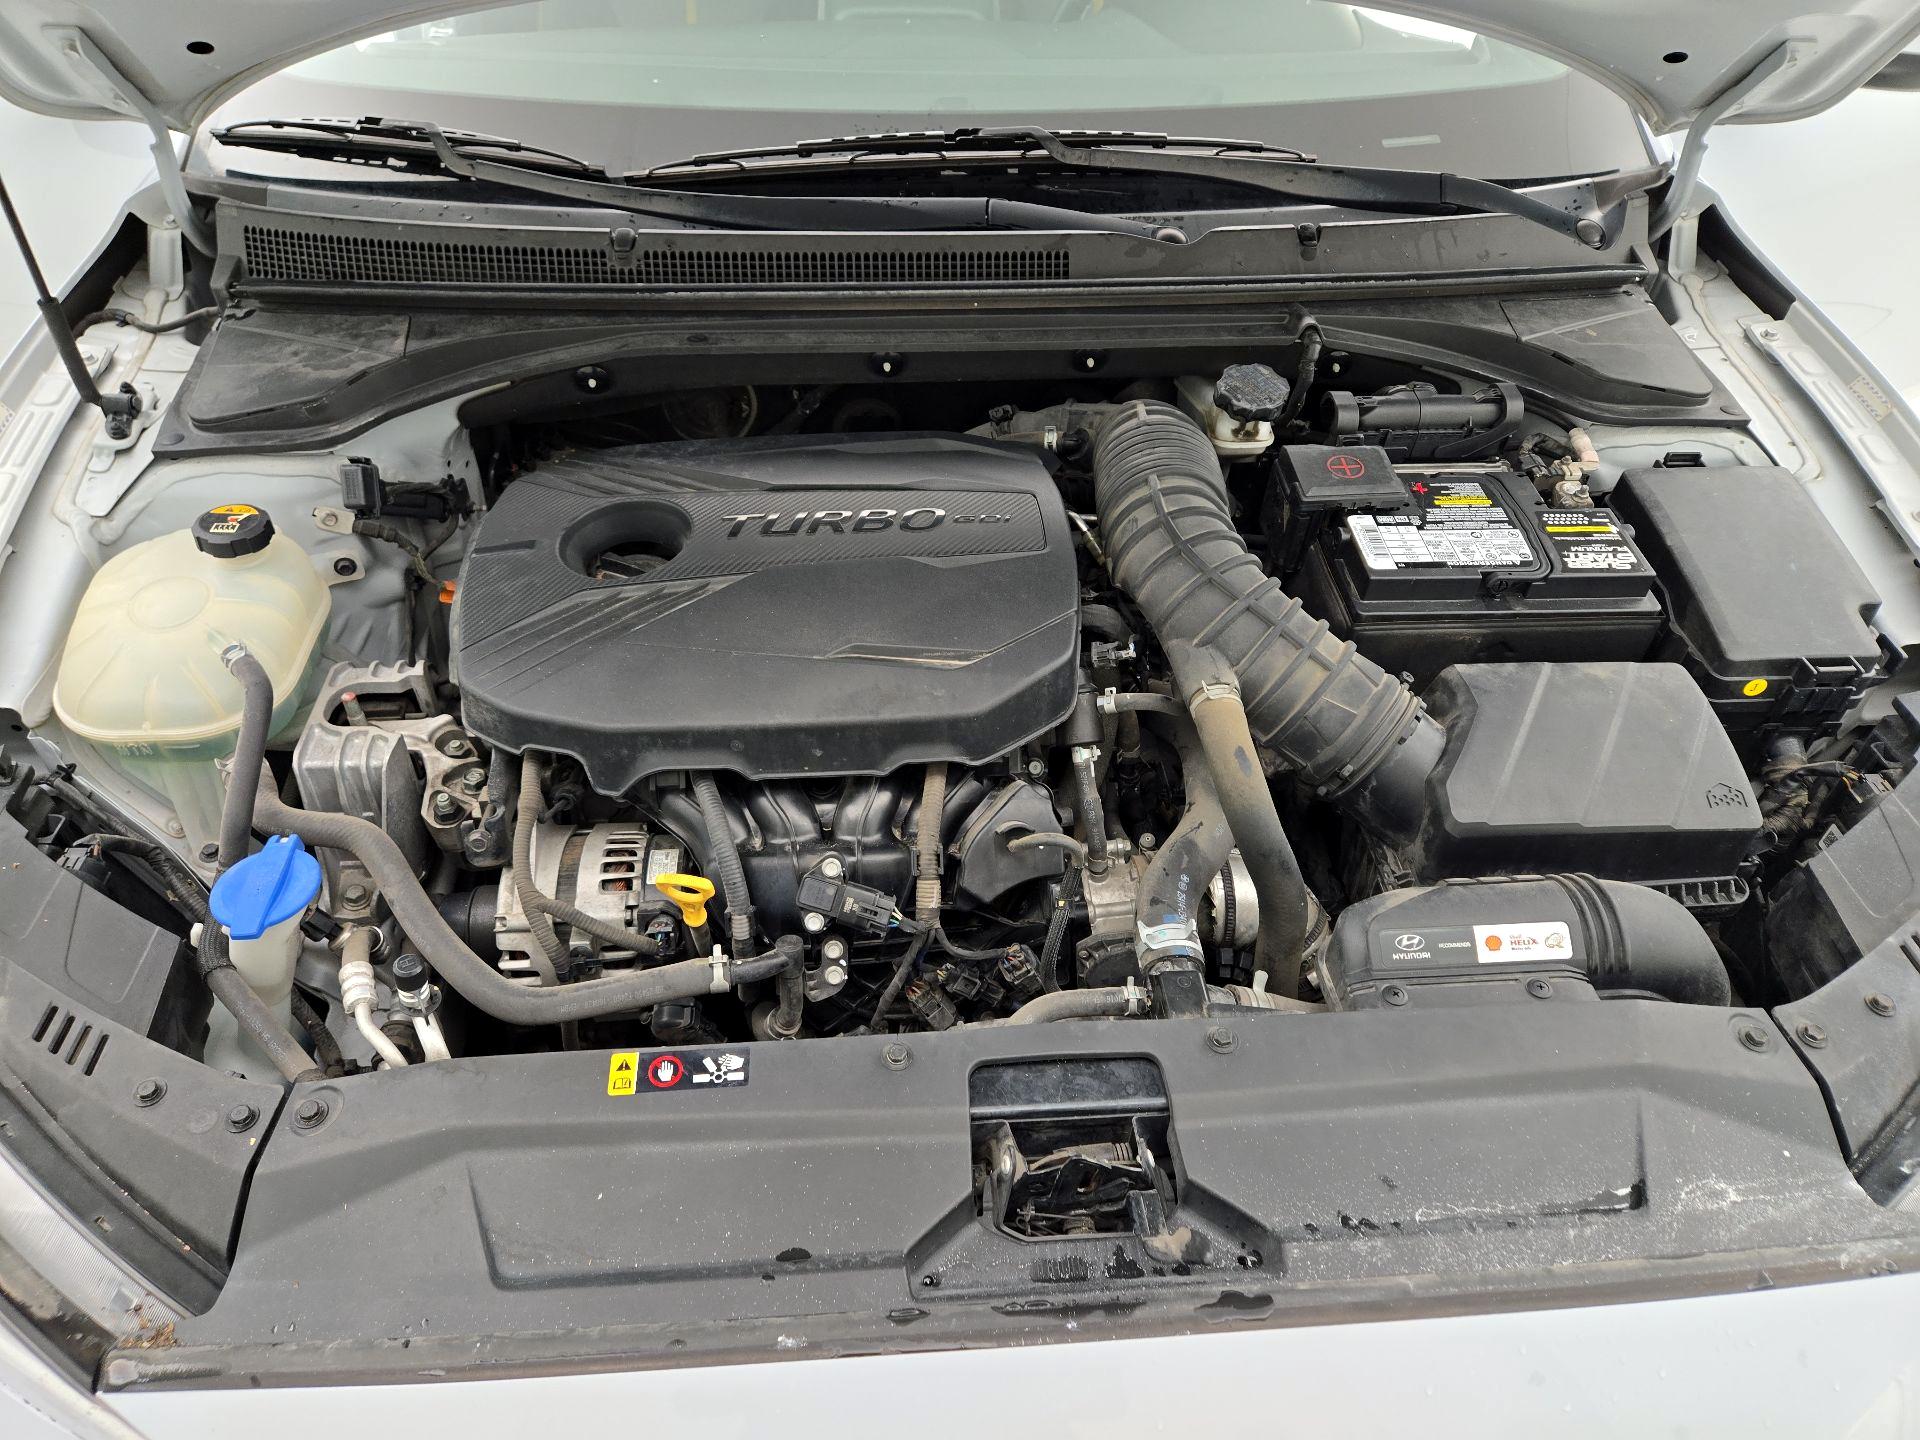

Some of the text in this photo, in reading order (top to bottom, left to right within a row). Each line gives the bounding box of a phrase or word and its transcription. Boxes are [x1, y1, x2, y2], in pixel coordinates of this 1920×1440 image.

[722, 507, 946, 538] TURBO
[1565, 553, 1634, 563] START
[1566, 561, 1632, 570] SUPER
[1510, 937, 1537, 946] HELIX
[1392, 952, 1432, 961] HYUNDAI
